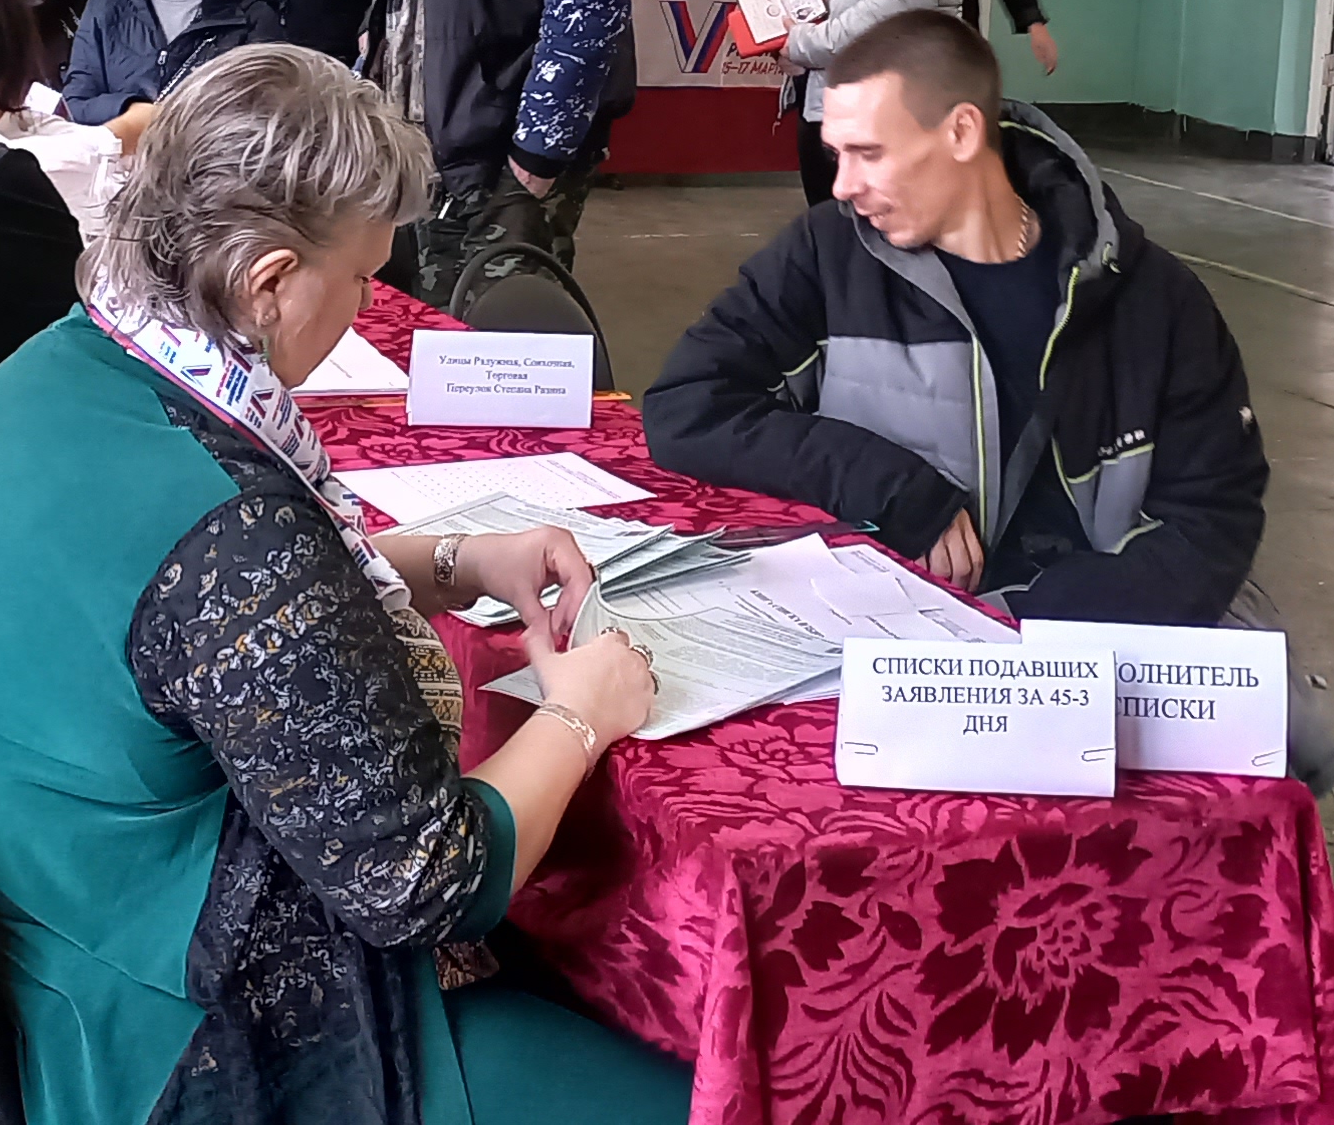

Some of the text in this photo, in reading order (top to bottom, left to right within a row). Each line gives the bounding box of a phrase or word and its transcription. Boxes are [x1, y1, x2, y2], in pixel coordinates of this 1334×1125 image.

[872, 657, 1099, 680] СПИСКИ ПОДАВШИХ
[1116, 662, 1260, 687] ОЛНИТЕЛЬ
[881, 686, 1089, 706] ЗАЯВЛЕНИЯ ЗА 45-3
[963, 715, 1008, 735] ДНЯ
